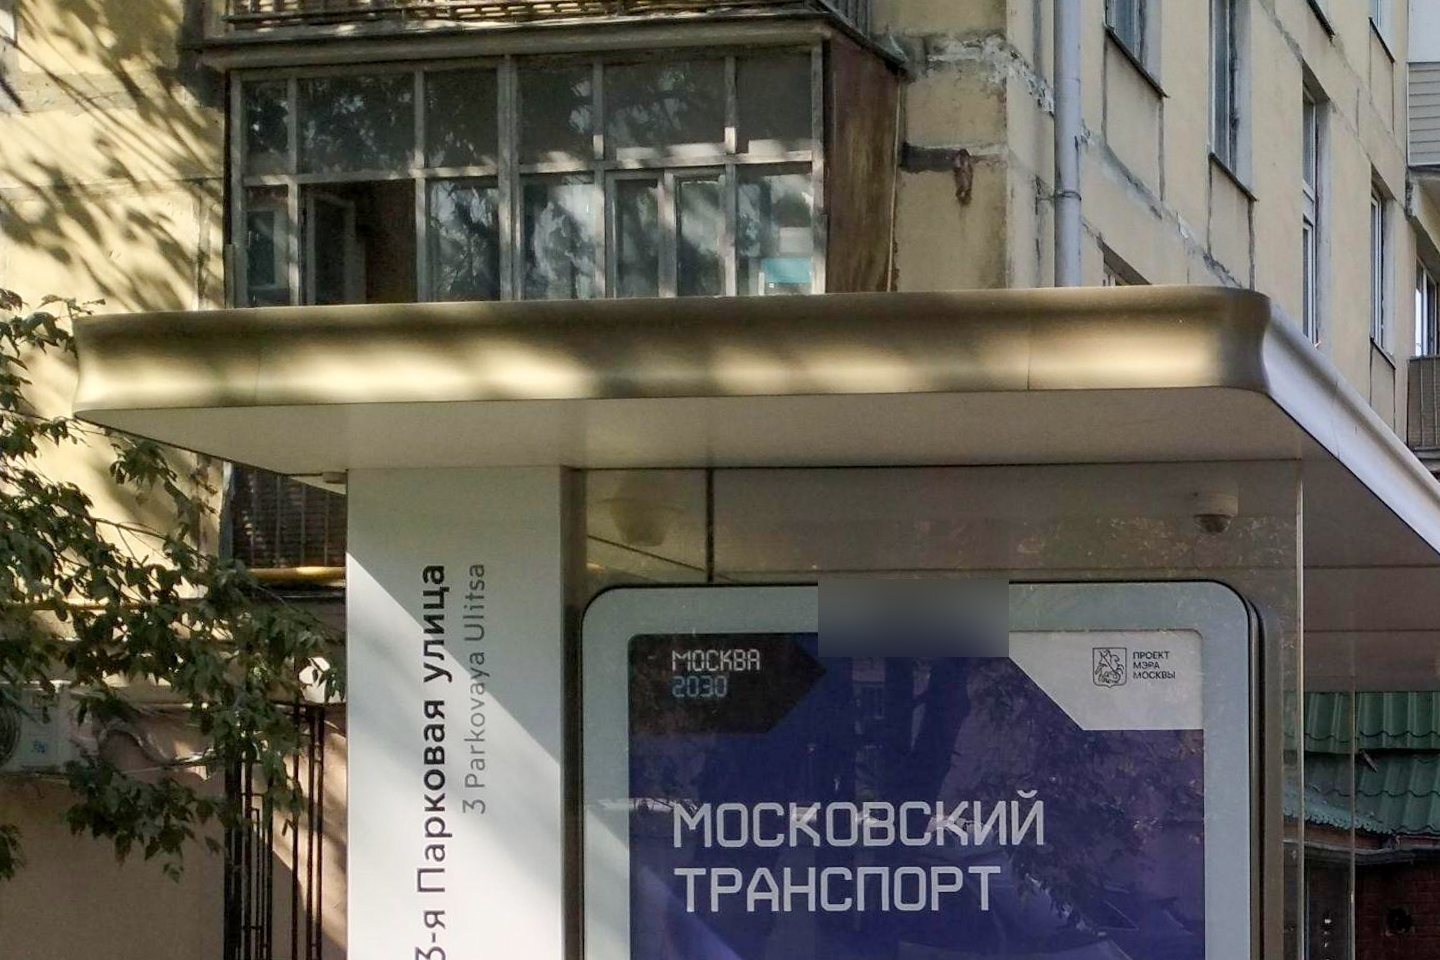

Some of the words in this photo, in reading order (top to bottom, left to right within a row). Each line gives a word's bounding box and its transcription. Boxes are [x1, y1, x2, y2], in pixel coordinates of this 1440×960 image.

[463, 562, 487, 643] Ulitsa
[423, 564, 452, 685] улица
[671, 648, 761, 672] МОСКВА
[1132, 651, 1170, 659] ПРОЕКТ
[1132, 661, 1160, 670] МЭРА
[671, 674, 728, 698] 2030
[1132, 671, 1176, 680] МОСКВЫ
[463, 651, 490, 790] Parkovaya
[416, 700, 452, 893] Парковая
[463, 797, 486, 815] 3
[673, 789, 1046, 849] МОСКОВСКИЙ
[674, 865, 1000, 912] ТРАНСПОРТ
